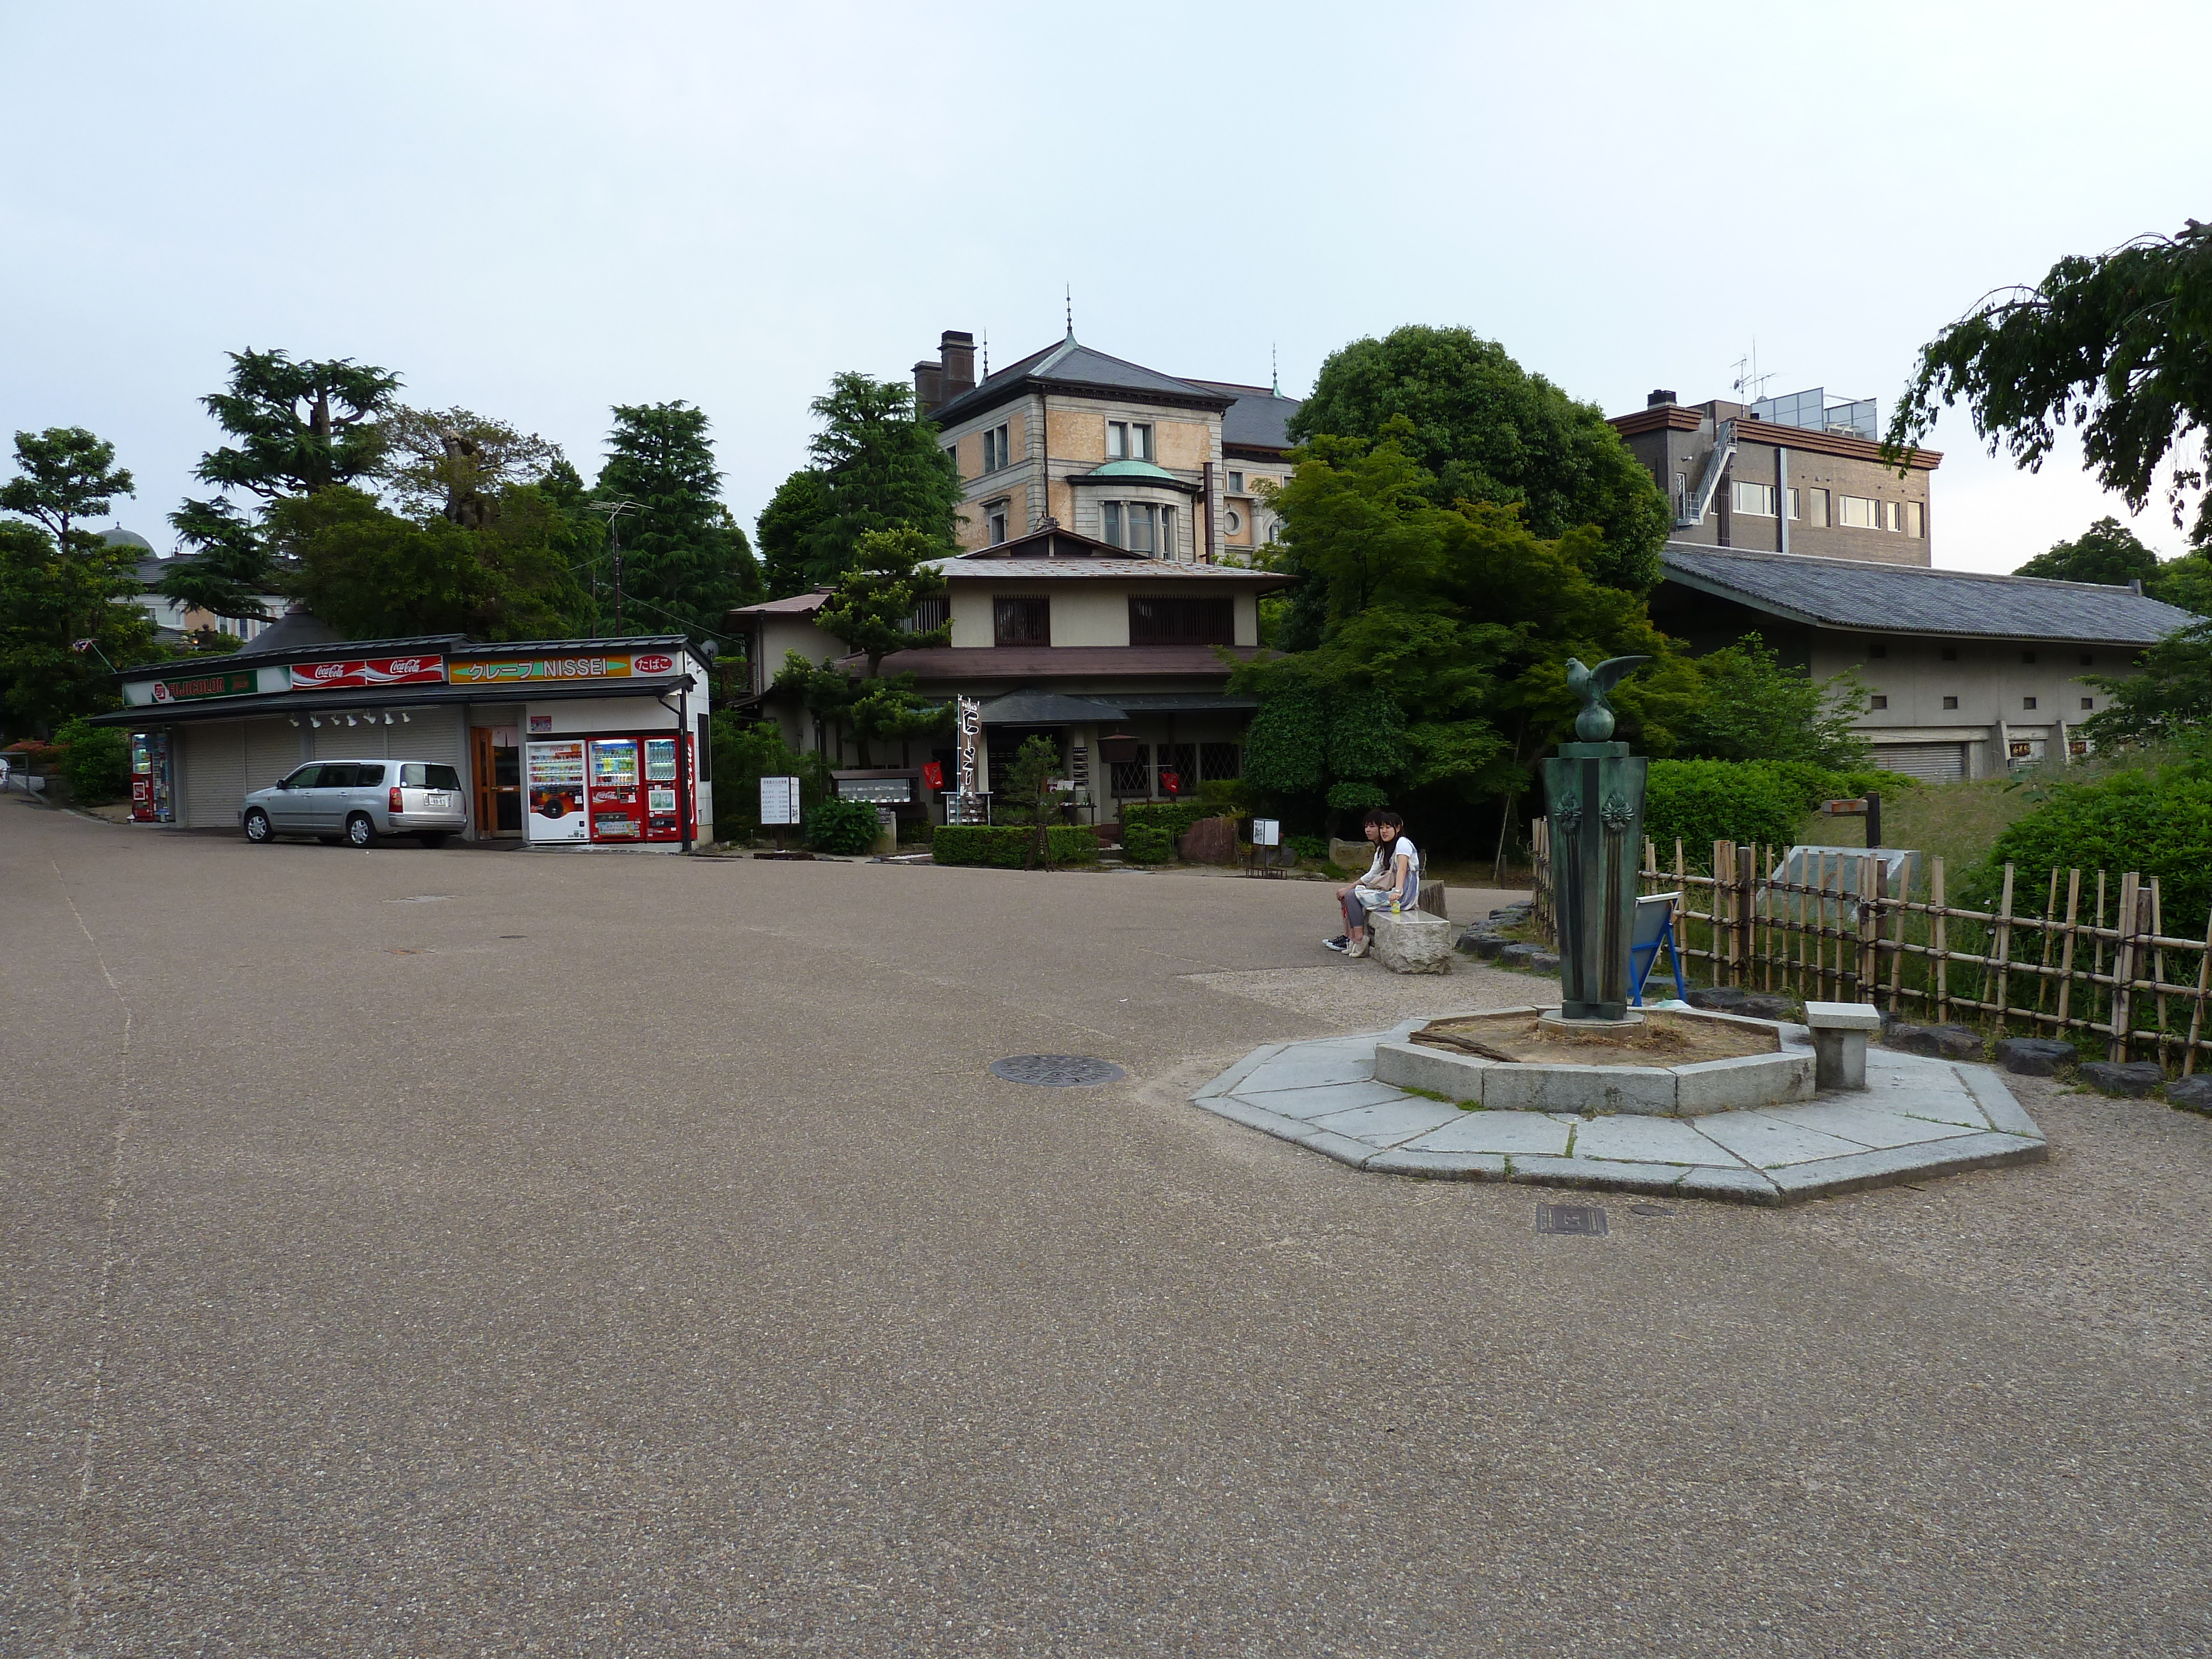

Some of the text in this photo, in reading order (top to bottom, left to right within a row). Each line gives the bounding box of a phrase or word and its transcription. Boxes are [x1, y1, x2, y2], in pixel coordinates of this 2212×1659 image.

[468, 658, 608, 681] クレープ NISSEI
[637, 658, 670, 671] たばこ
[168, 677, 225, 697] FUJICOLOR
